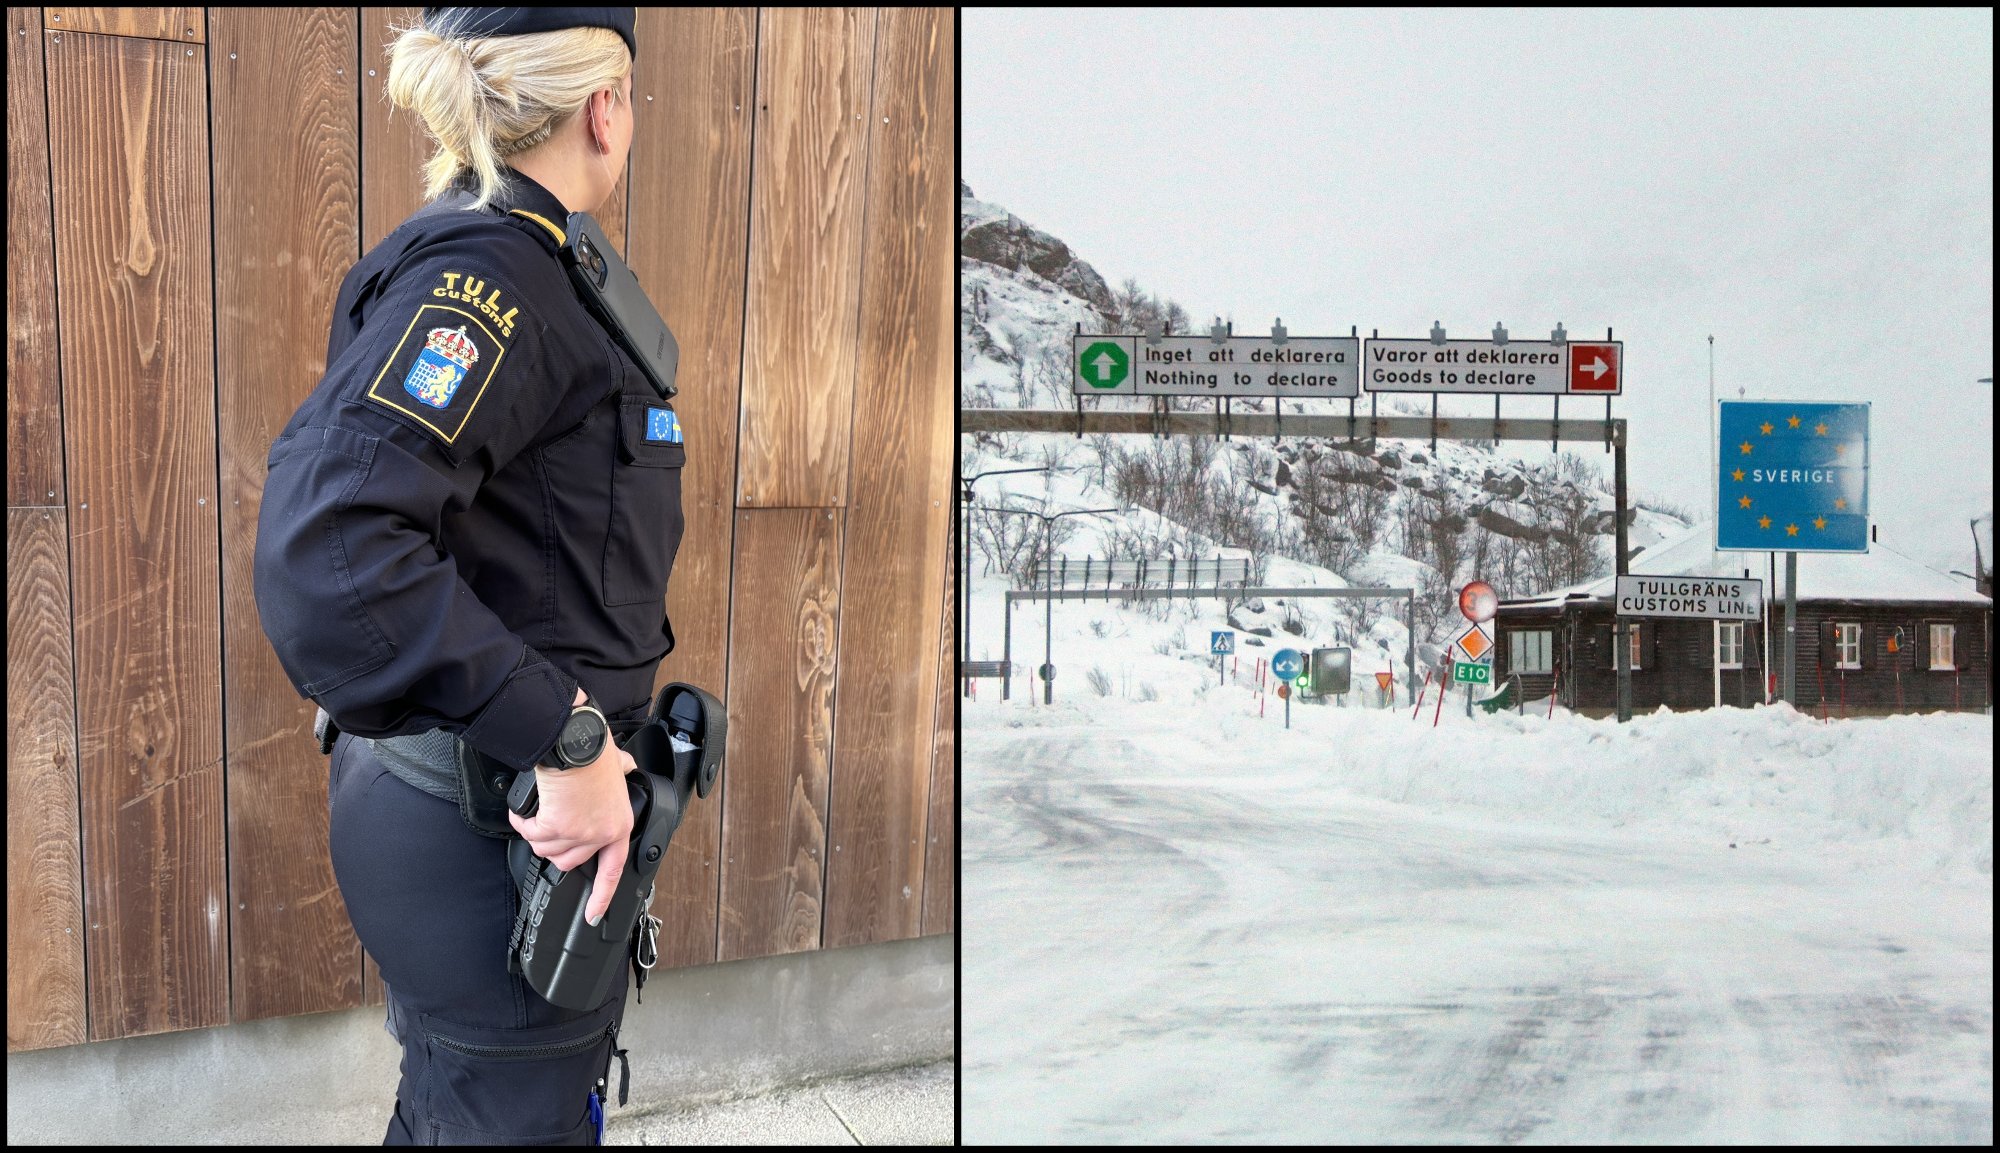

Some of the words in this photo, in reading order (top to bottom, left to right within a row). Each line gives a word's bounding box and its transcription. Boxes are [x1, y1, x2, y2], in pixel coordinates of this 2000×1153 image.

[443, 271, 519, 328] TULL
[433, 288, 511, 338] Customs
[1145, 346, 1192, 364] Inget
[1208, 348, 1234, 363] att
[1250, 348, 1345, 363] deklarera
[1373, 348, 1427, 363] Varor
[1434, 348, 1459, 364] att
[1466, 349, 1560, 364] deklarera
[1145, 370, 1218, 388] Nothing
[1234, 371, 1252, 385] to
[1267, 371, 1338, 386] declare
[1372, 369, 1432, 385] Goods
[1439, 370, 1458, 384] to
[1465, 370, 1536, 386] declare
[1753, 469, 1834, 483] SVERIGE
[1638, 580, 1741, 598] TULLGRÄNS
[1622, 597, 1707, 612] CUSTOMS
[1718, 601, 1755, 615] LINE
[1457, 666, 1486, 680] E10
